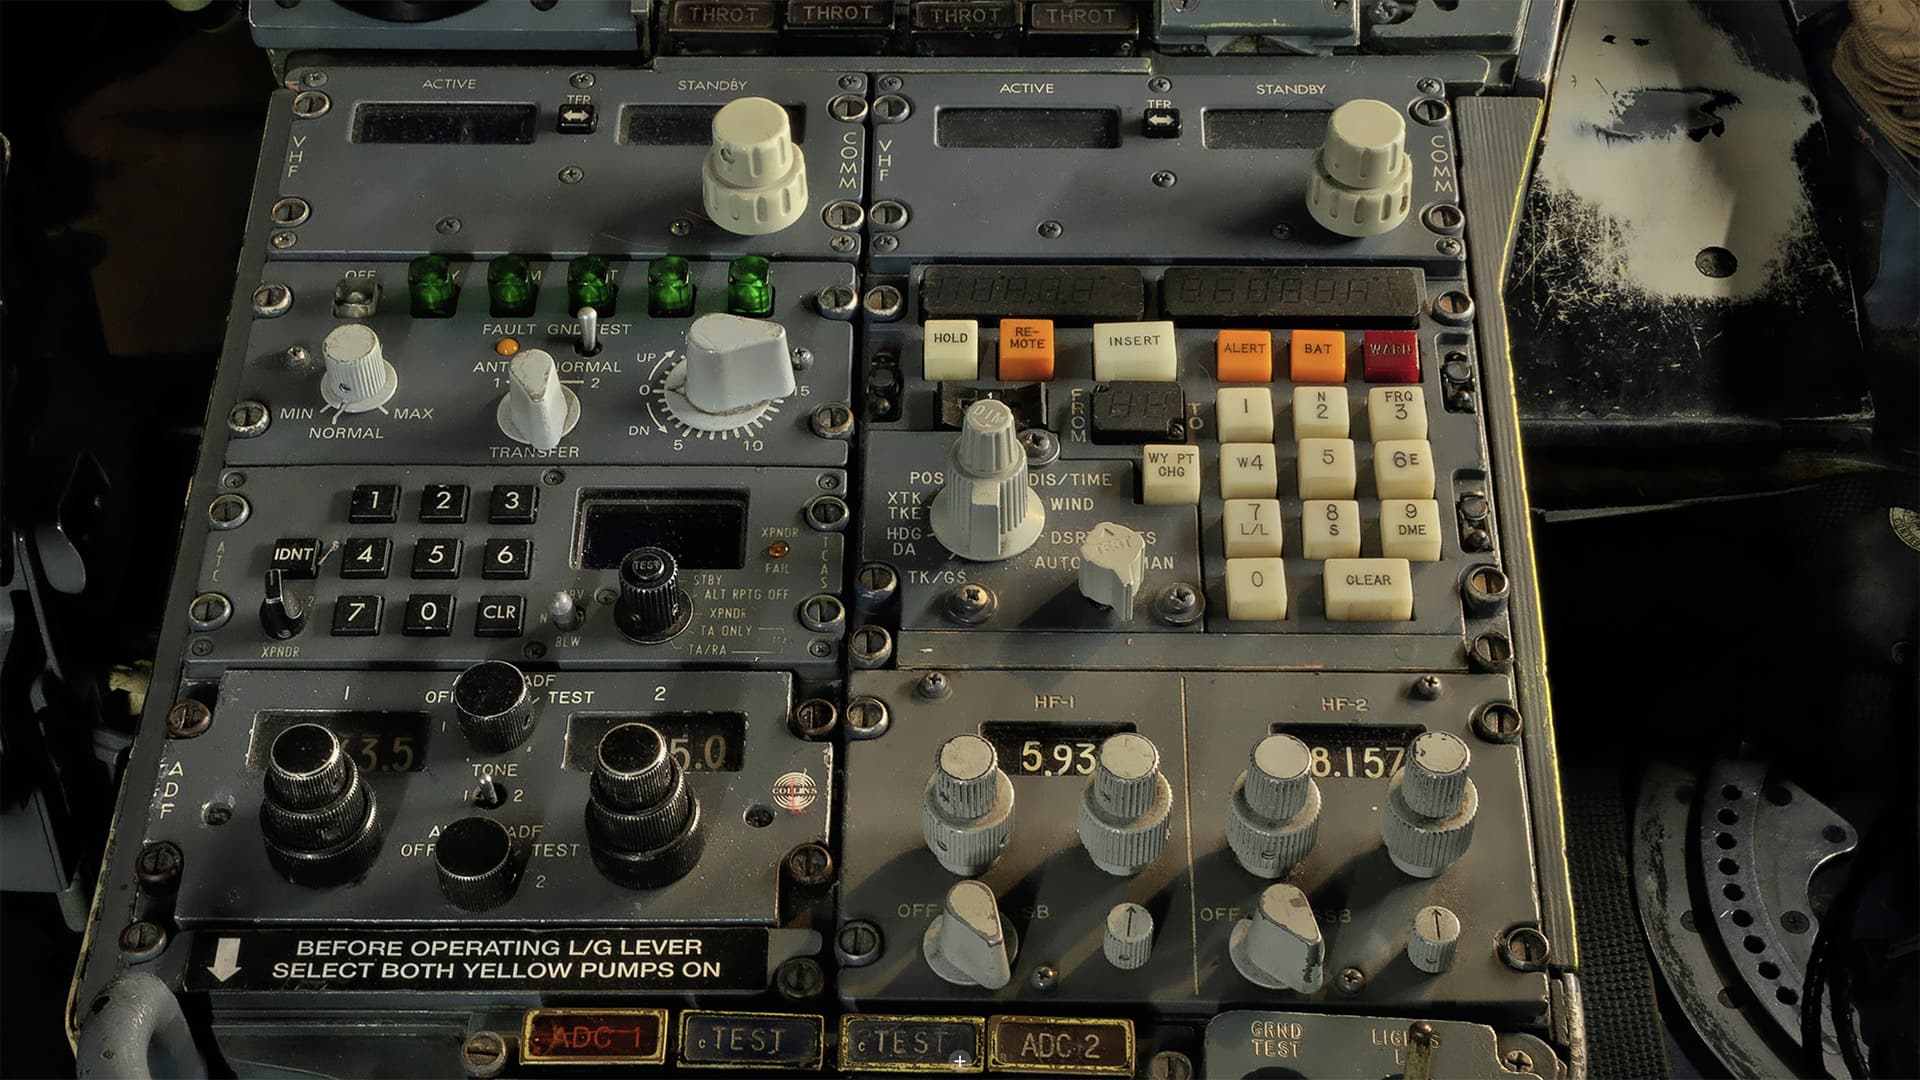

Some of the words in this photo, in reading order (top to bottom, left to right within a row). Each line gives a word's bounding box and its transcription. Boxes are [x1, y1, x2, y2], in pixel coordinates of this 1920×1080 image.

[690, 7, 759, 22] THROT
[803, 6, 874, 20] THROT
[930, 8, 1001, 23] THROT
[1046, 9, 1116, 23] THROT
[422, 79, 477, 89] ACTIVE
[678, 80, 748, 91] STANDBY
[1000, 83, 1054, 94] ACTIVE
[1256, 84, 1327, 95] STANDBY
[287, 136, 306, 178] VHF
[839, 132, 858, 189] COMM
[878, 140, 892, 182] VHF
[1431, 135, 1453, 193] COMM
[482, 324, 537, 335] FAULT
[1015, 327, 1040, 337] RE-
[934, 333, 968, 344] HOLD
[1010, 338, 1045, 349] MOTE
[1109, 336, 1161, 346] INSERT
[1224, 343, 1266, 354] ALERT
[1305, 343, 1333, 354] BAT
[636, 354, 656, 363] UP
[494, 378, 500, 388] 1
[591, 378, 600, 388] 2
[639, 385, 650, 396] 0
[1317, 392, 1326, 402] N
[1385, 391, 1413, 402] FRQ
[1244, 398, 1249, 414] 1
[1316, 404, 1329, 419] 2
[1395, 404, 1408, 420] 3
[280, 409, 314, 419] MIN
[394, 409, 434, 419] MAX
[1071, 388, 1087, 443] FROM
[1187, 402, 1204, 430] TO
[309, 428, 384, 439] NORMAL
[629, 426, 650, 436] DN
[674, 440, 684, 450] 5
[744, 440, 763, 451] 10
[489, 447, 580, 458] TRANSFER
[1322, 449, 1335, 465] 5
[910, 472, 944, 484] POS
[1158, 467, 1185, 477] CHG
[1029, 473, 1113, 486] DIS/TIME
[372, 491, 379, 509] 1
[436, 491, 451, 510] 2
[504, 491, 520, 510] 3
[888, 492, 921, 505] XTK
[1050, 498, 1094, 511] WIND
[888, 507, 921, 520] TKE
[1247, 504, 1261, 520] 7
[1326, 504, 1339, 521] 8
[1405, 503, 1418, 519] 9
[761, 528, 799, 538] XPNDR
[887, 528, 921, 540] HDG
[1241, 524, 1269, 535] L/L
[1329, 524, 1339, 536] S
[1398, 525, 1426, 536] DME
[274, 548, 314, 560] IDNT
[357, 545, 373, 562] 4
[428, 545, 445, 563] 5
[497, 545, 513, 564] 6
[893, 543, 916, 555] DA
[765, 563, 790, 574] FAIL
[820, 537, 831, 589] TCAS
[694, 575, 723, 585] STBY
[908, 571, 967, 584] TK/GS
[1251, 571, 1264, 588] 0
[1346, 575, 1392, 586] CLEAR
[704, 589, 726, 600] ALT
[733, 589, 761, 600] RPTG
[768, 589, 790, 600] OFF
[347, 602, 366, 622] 7
[421, 602, 437, 621] 0
[483, 605, 516, 619] CLR
[710, 608, 748, 619] XPNDR
[700, 626, 718, 636] TA
[722, 626, 752, 636] ONLY
[555, 636, 581, 648] BLW
[261, 646, 300, 658] XPNDR
[688, 644, 727, 655] TA/RA
[549, 691, 595, 704] TEST
[654, 686, 666, 701] 2
[1033, 695, 1075, 710] HF-1
[1321, 698, 1368, 712] HF-2
[472, 763, 518, 777] TONE
[160, 761, 183, 819] ADF
[513, 790, 524, 802] 2
[400, 844, 436, 857] OFF
[532, 844, 580, 857] TEST
[536, 876, 546, 888] 2
[897, 904, 938, 918] OFF
[1200, 907, 1240, 921] OFF
[297, 940, 403, 957] BEFORE
[411, 940, 560, 957] OPERATING
[569, 940, 612, 956] L/G
[621, 940, 702, 956] LEVER
[272, 963, 374, 979] SELECT
[381, 963, 453, 979] BOTH
[463, 963, 573, 979] YELLOW
[580, 962, 674, 978] PUMPS
[682, 961, 721, 978] ON
[1250, 1020, 1302, 1040] GRND
[551, 1026, 612, 1049] ADC
[632, 1026, 641, 1048] 1
[712, 1026, 788, 1053] TEST
[875, 1030, 946, 1054] TEST
[1371, 1028, 1441, 1049] LIGS
[1021, 1033, 1072, 1058] ADC
[1084, 1034, 1101, 1059] 2
[1251, 1039, 1300, 1058] TEST
